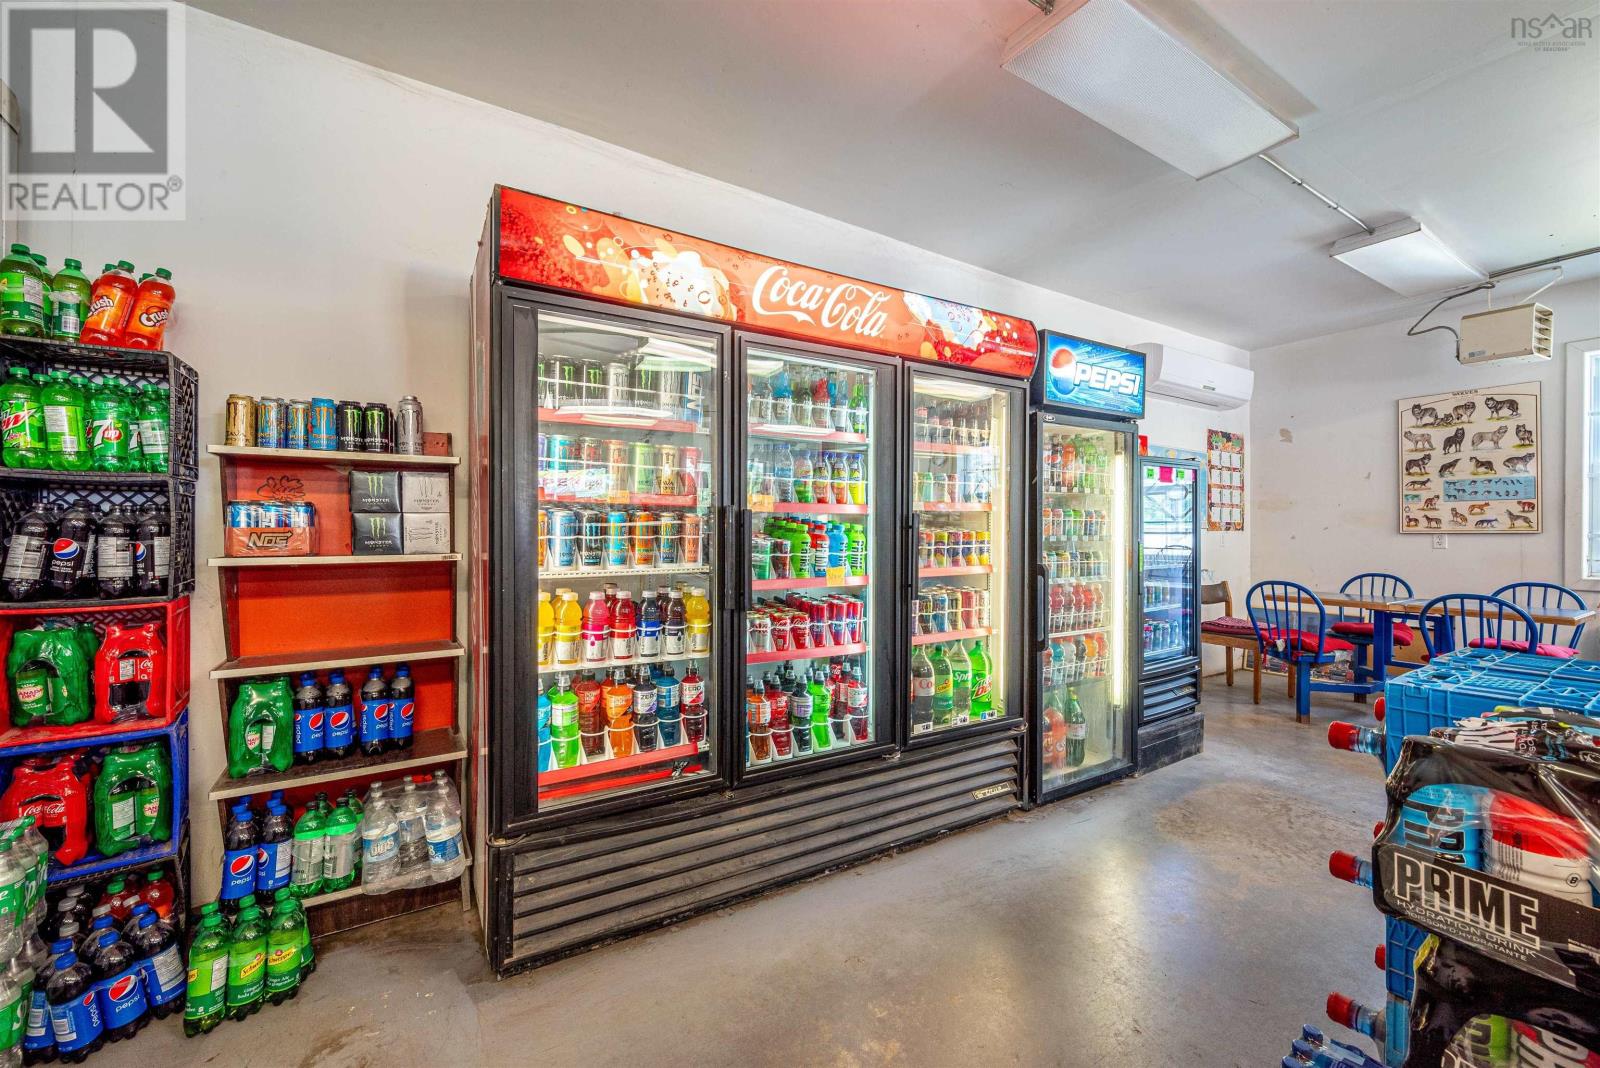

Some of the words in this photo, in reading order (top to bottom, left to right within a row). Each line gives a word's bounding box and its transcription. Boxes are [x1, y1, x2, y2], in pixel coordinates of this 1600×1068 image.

[752, 265, 892, 337] Coca-Cola
[1073, 362, 1141, 396] PEPSI
[247, 530, 294, 550] NOS
[51, 560, 74, 568] pepsi
[231, 876, 252, 886] pepsi
[1394, 852, 1541, 951] PRIME
[1395, 900, 1484, 937] HYDRATION
[1484, 932, 1537, 958] DRINK
[115, 994, 140, 1013] pepsi
